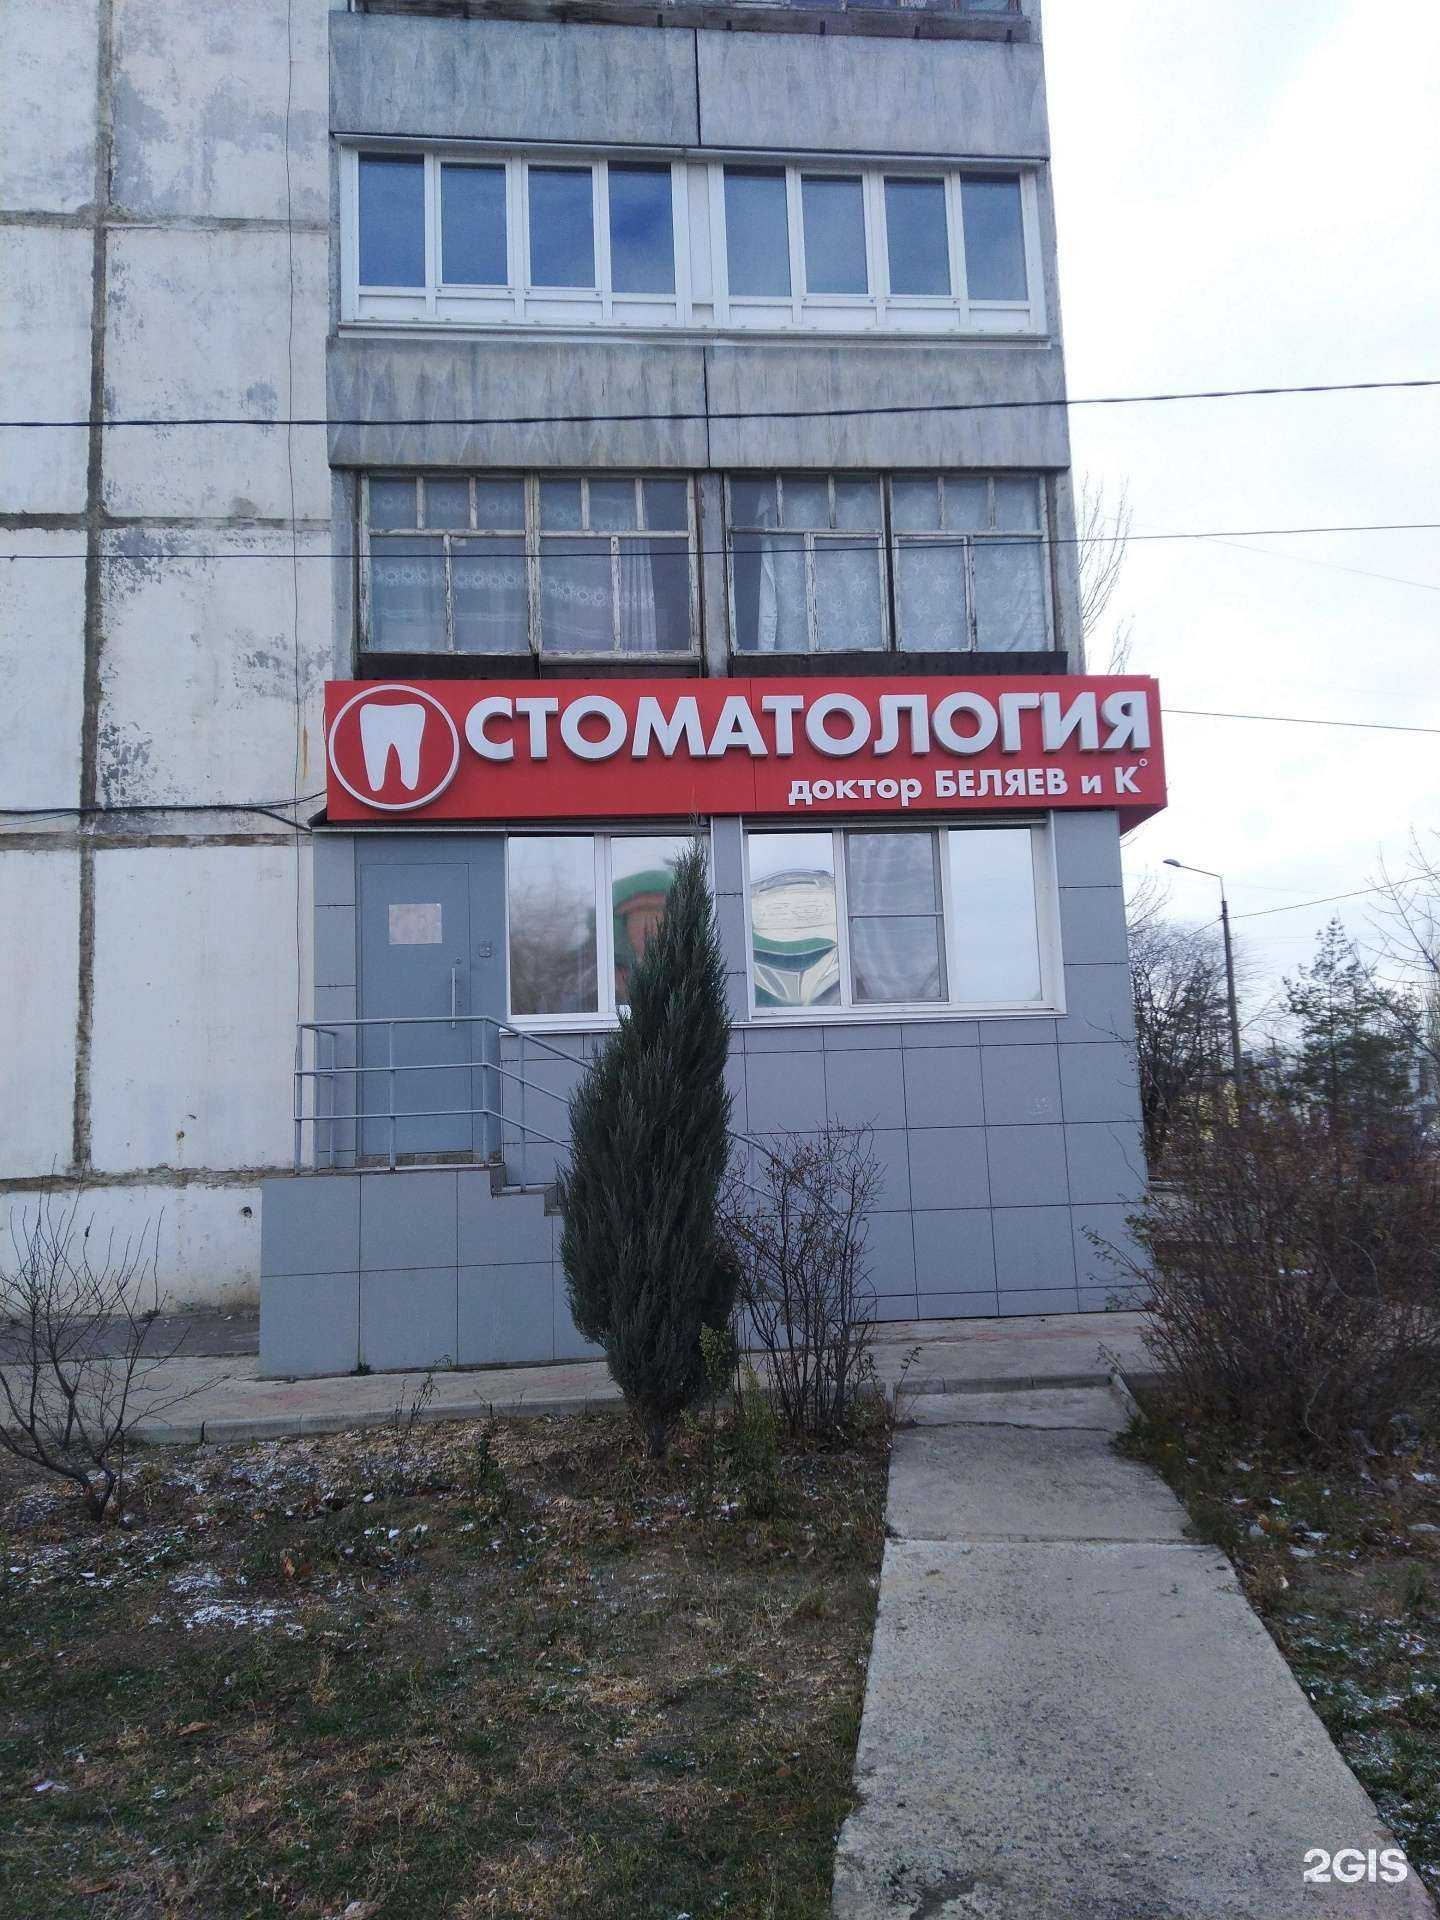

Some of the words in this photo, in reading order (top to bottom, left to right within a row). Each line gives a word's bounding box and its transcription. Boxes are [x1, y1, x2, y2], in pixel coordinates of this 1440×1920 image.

[464, 690, 1151, 760] СТОМАТОЛОГИЯ
[788, 777, 922, 806] доктор
[935, 768, 1068, 797] БЕЛЯЕВ
[1080, 775, 1102, 794] и
